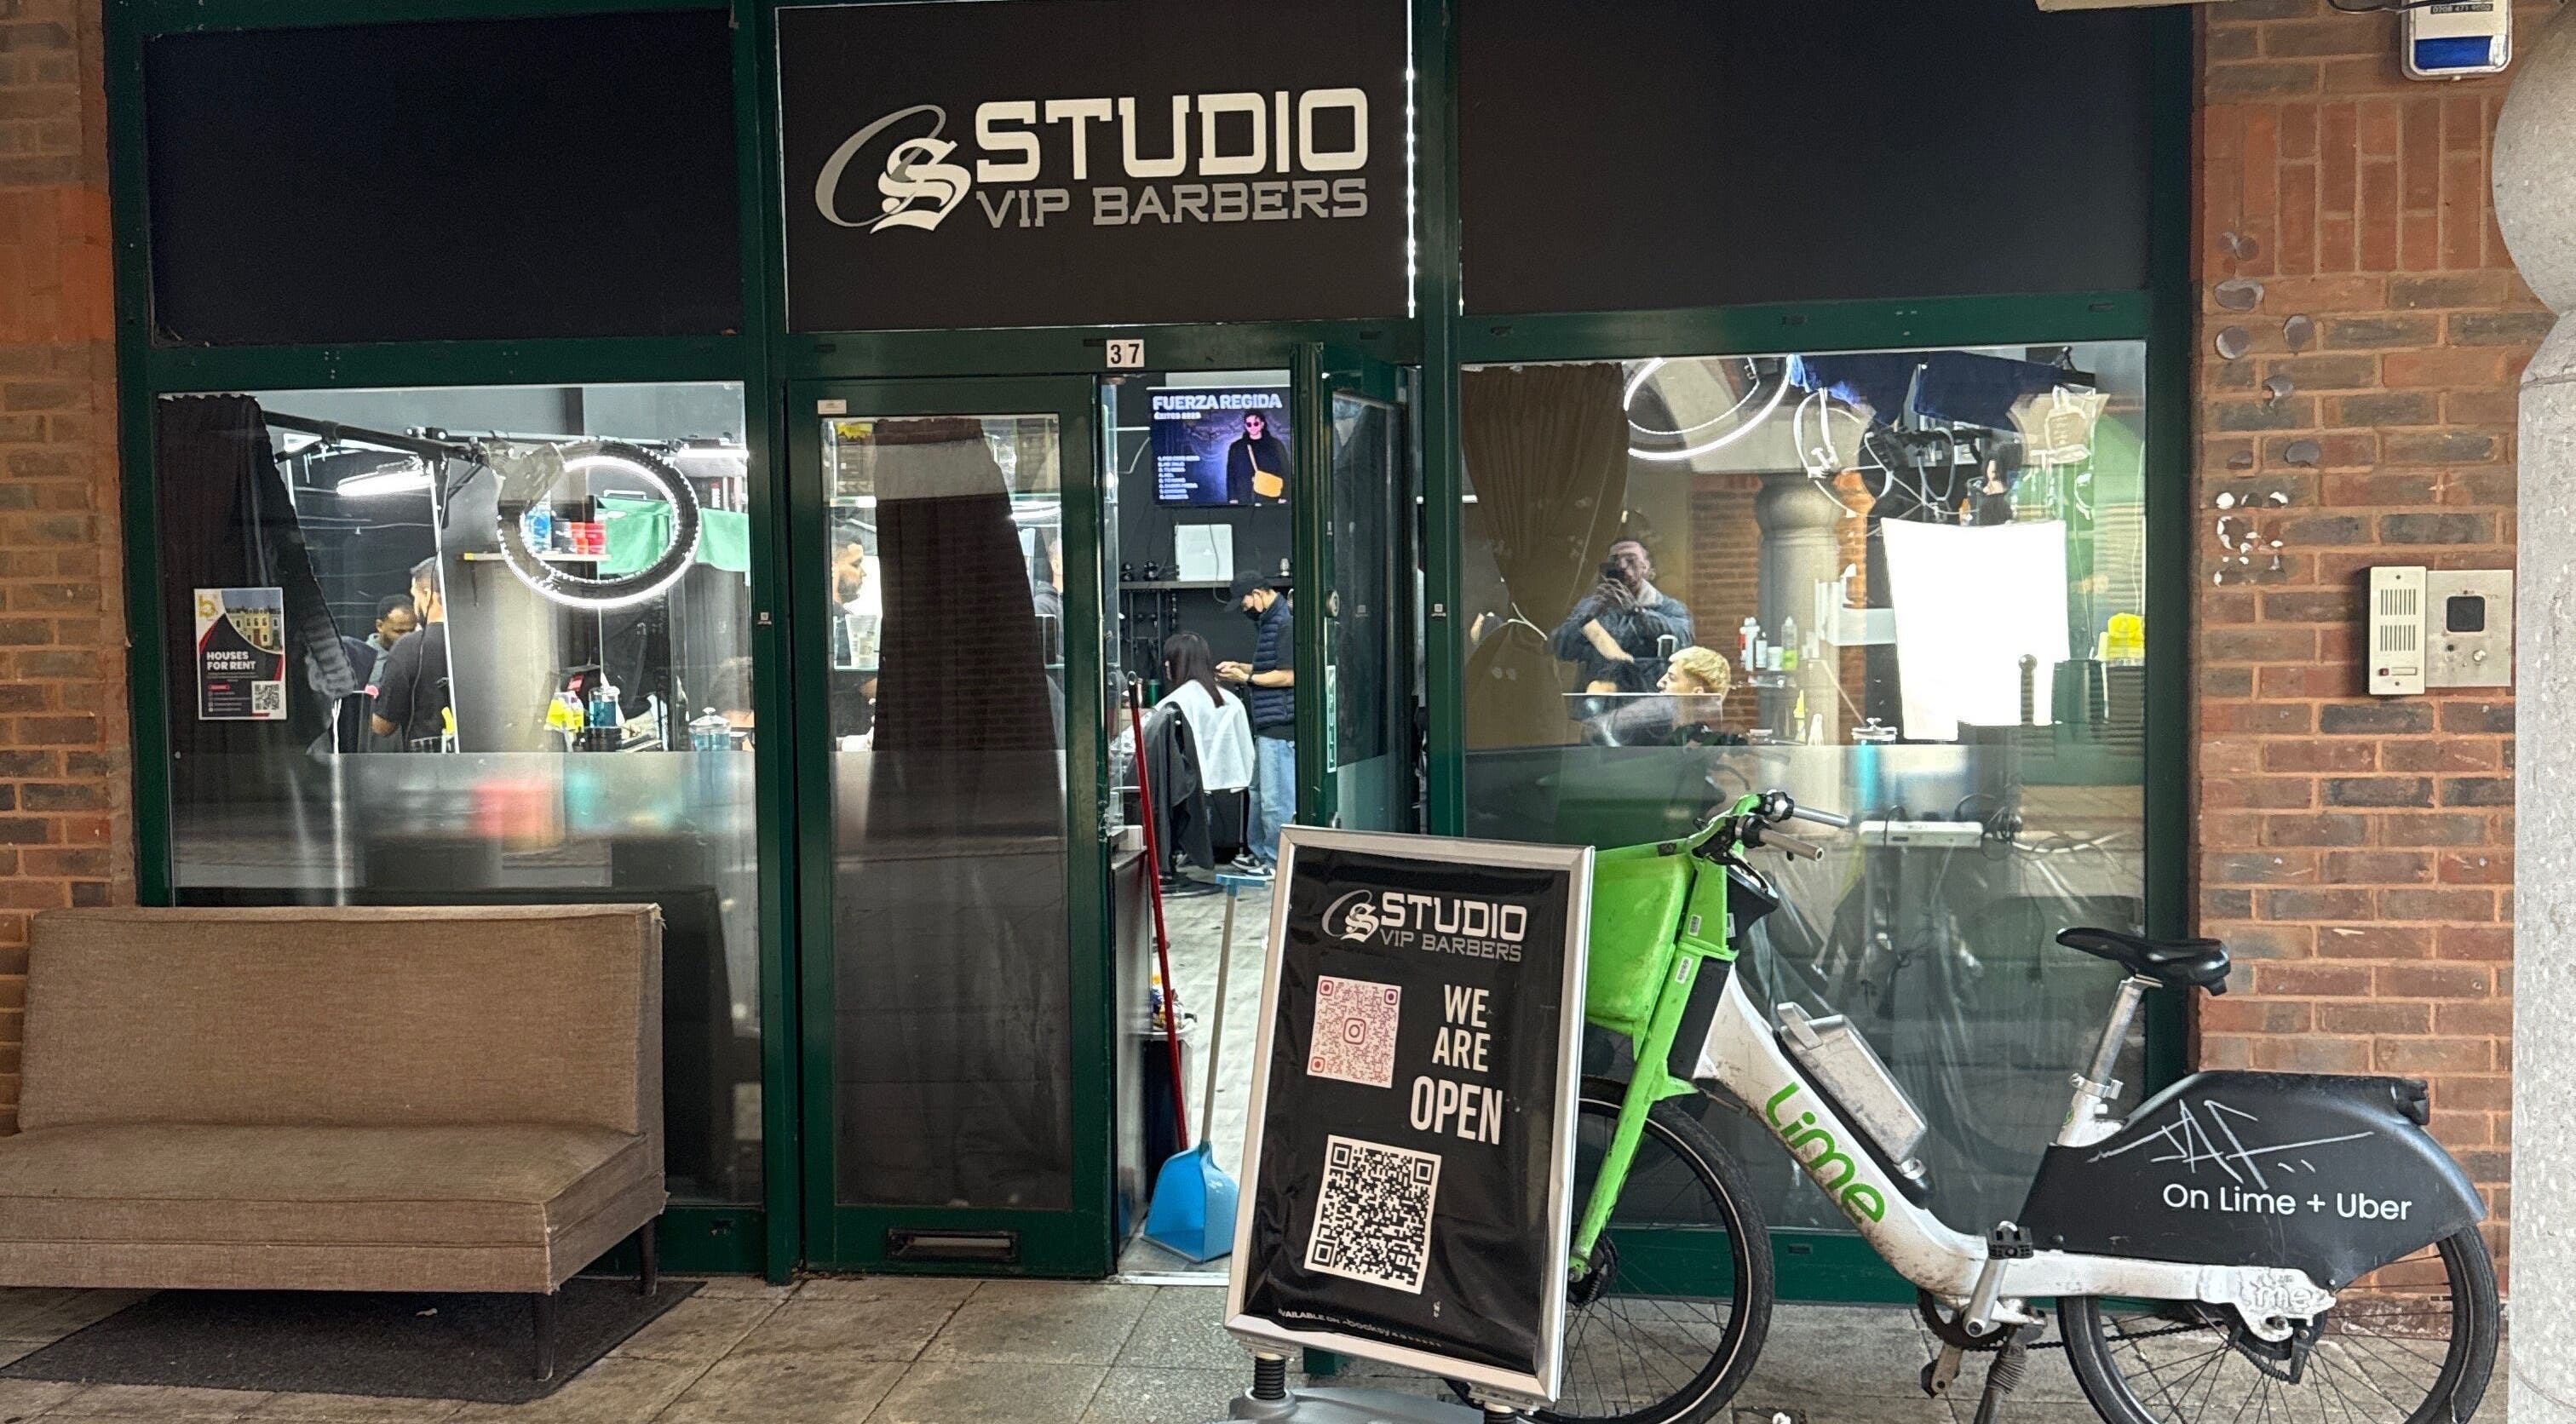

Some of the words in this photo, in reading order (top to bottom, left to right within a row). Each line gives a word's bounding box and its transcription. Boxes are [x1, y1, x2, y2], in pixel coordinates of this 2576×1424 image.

[975, 88, 1369, 182] STUDIO
[976, 187, 1071, 228] VIP
[1092, 178, 1368, 225] BARBERS
[1110, 343, 1141, 365] 37
[1153, 394, 1219, 411] FUERZA
[1220, 393, 1283, 410] REGIDA
[206, 651, 249, 661] HOUSES
[207, 661, 228, 671] FOR
[230, 661, 256, 670] RENT
[1380, 892, 1527, 942] STUDIO
[1379, 927, 1415, 948] VIP
[1421, 933, 1522, 962] BARBERS
[1444, 984, 1490, 1029] WE
[1432, 1026, 1492, 1072] ARE
[1410, 1075, 1504, 1146] OPEN
[1766, 1082, 1885, 1224] Lime
[2163, 1183, 2210, 1209] On
[2220, 1186, 2297, 1215] Lime
[2307, 1193, 2326, 1213] +
[2337, 1191, 2412, 1220] Uber
